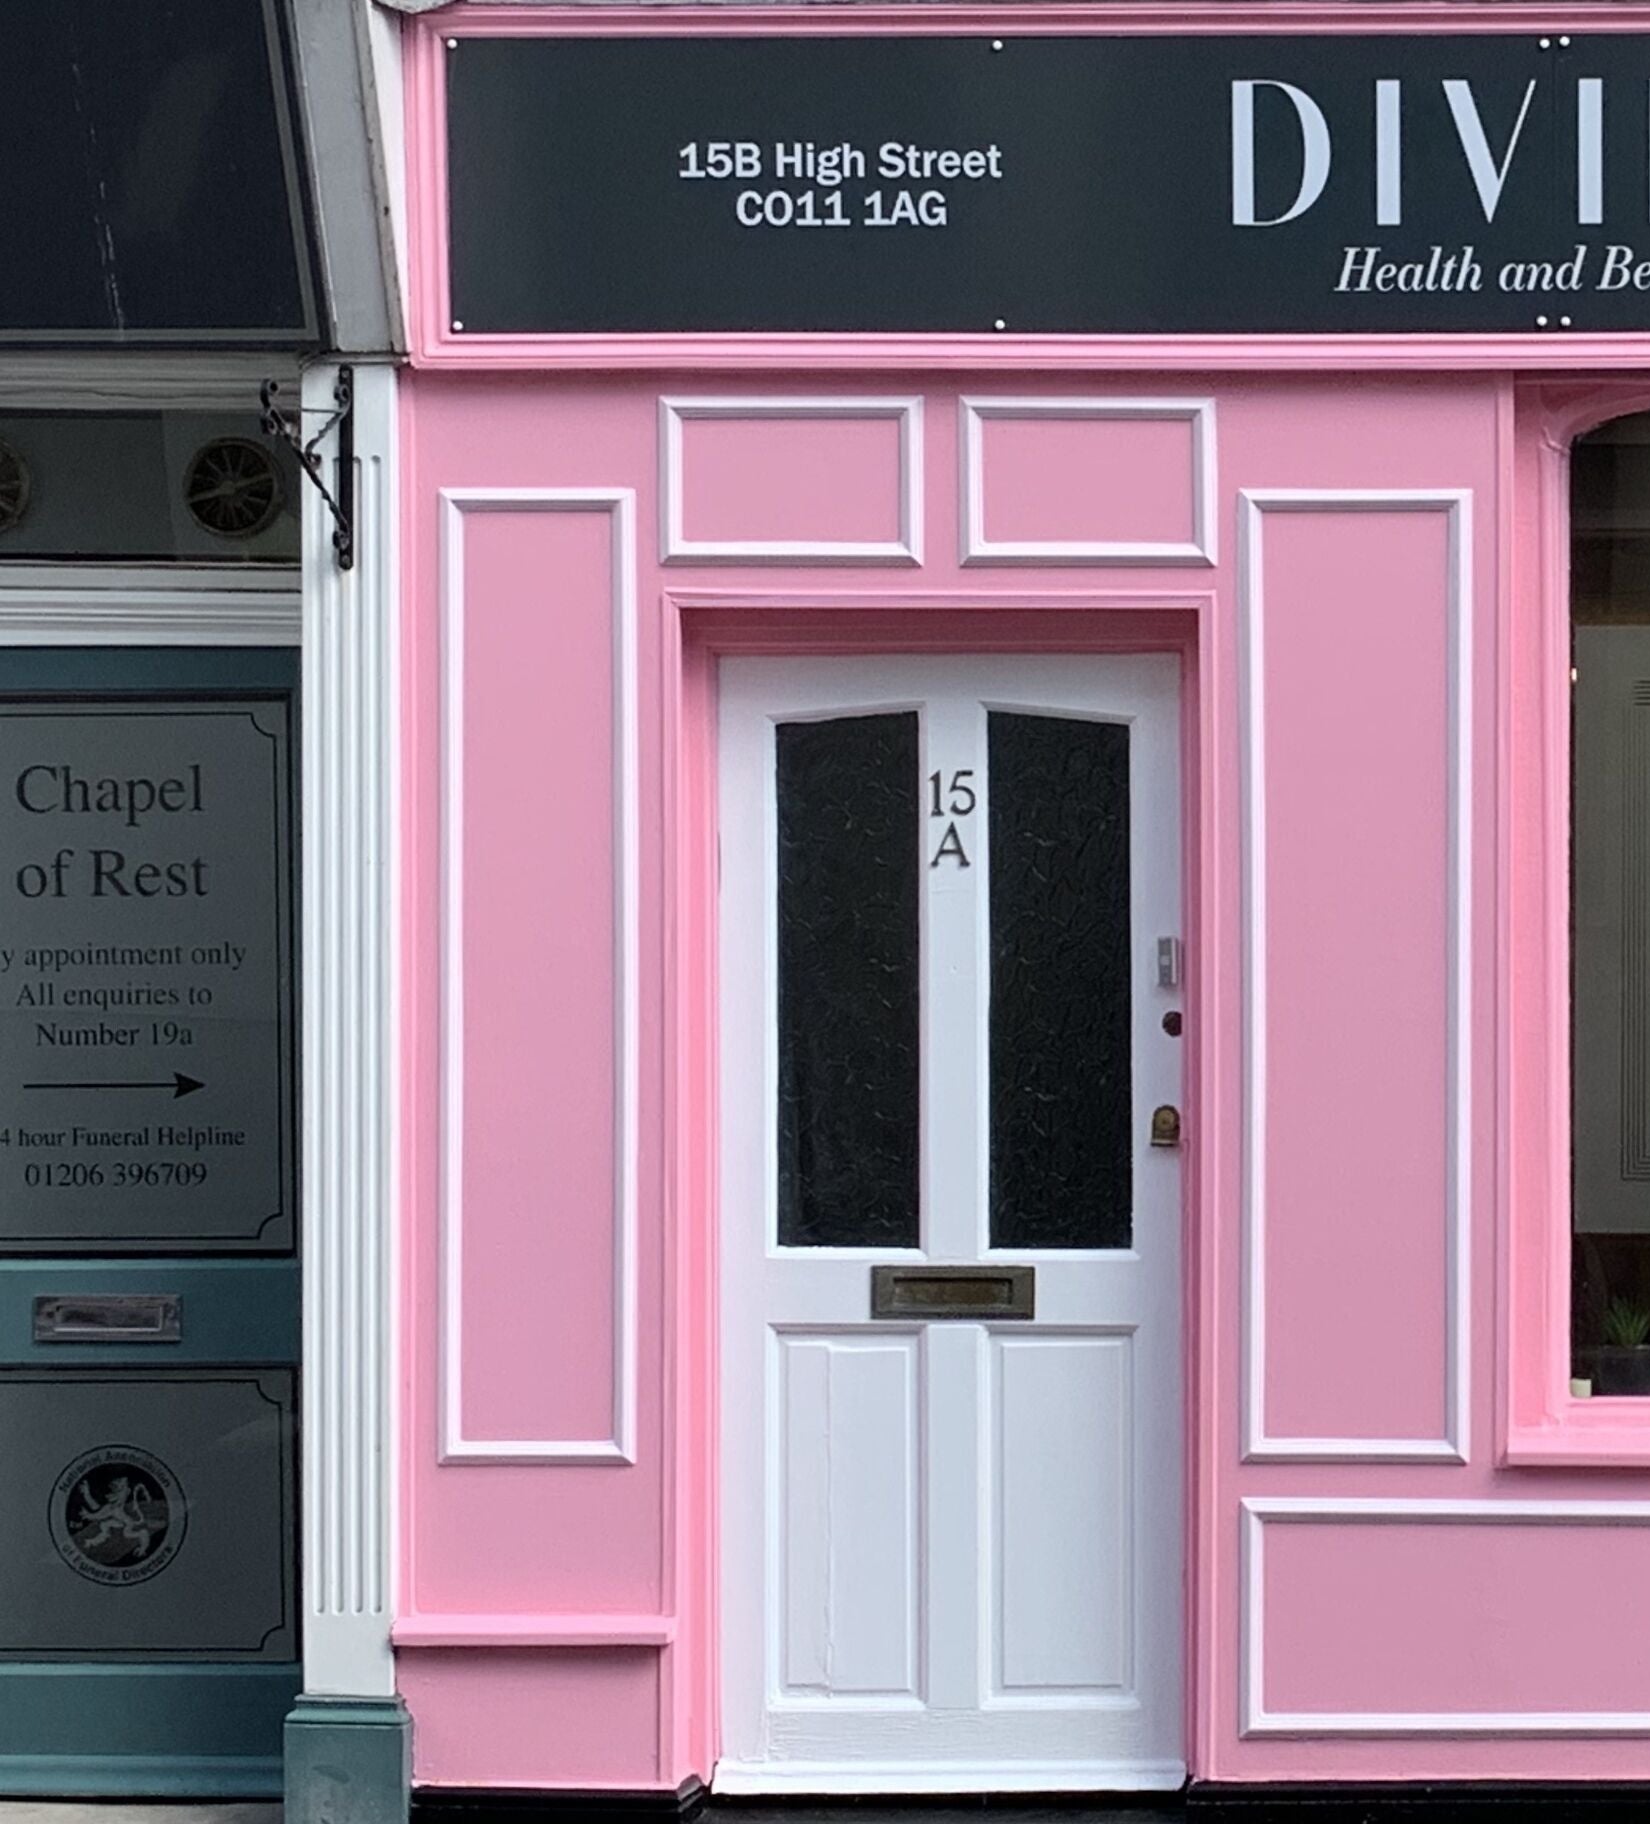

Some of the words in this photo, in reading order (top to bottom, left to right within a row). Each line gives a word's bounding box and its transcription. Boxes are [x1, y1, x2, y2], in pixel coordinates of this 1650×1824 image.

[679, 142, 762, 178] 15B
[775, 142, 865, 186] High
[878, 142, 1002, 179] Street
[736, 190, 851, 226] CO11
[864, 190, 947, 226] 1AG
[1333, 245, 1483, 292] Health
[1498, 245, 1583, 292] and
[15, 763, 205, 827] Chapel
[928, 769, 977, 817] 15
[930, 821, 971, 869] A
[16, 849, 75, 898] of
[89, 849, 209, 898] Rest
[0, 948, 15, 973] y
[23, 941, 182, 972] appointment
[190, 941, 247, 970] only
[16, 981, 54, 1007] All
[62, 981, 180, 1012] enquiries
[187, 985, 213, 1006] to
[35, 1021, 140, 1047] Number
[150, 1021, 193, 1047] 19a
[18, 1126, 67, 1148] hour
[72, 1125, 150, 1148] Funeral
[157, 1125, 246, 1154] Helpline
[24, 1161, 104, 1187] 01206
[112, 1161, 209, 1187] 396709
